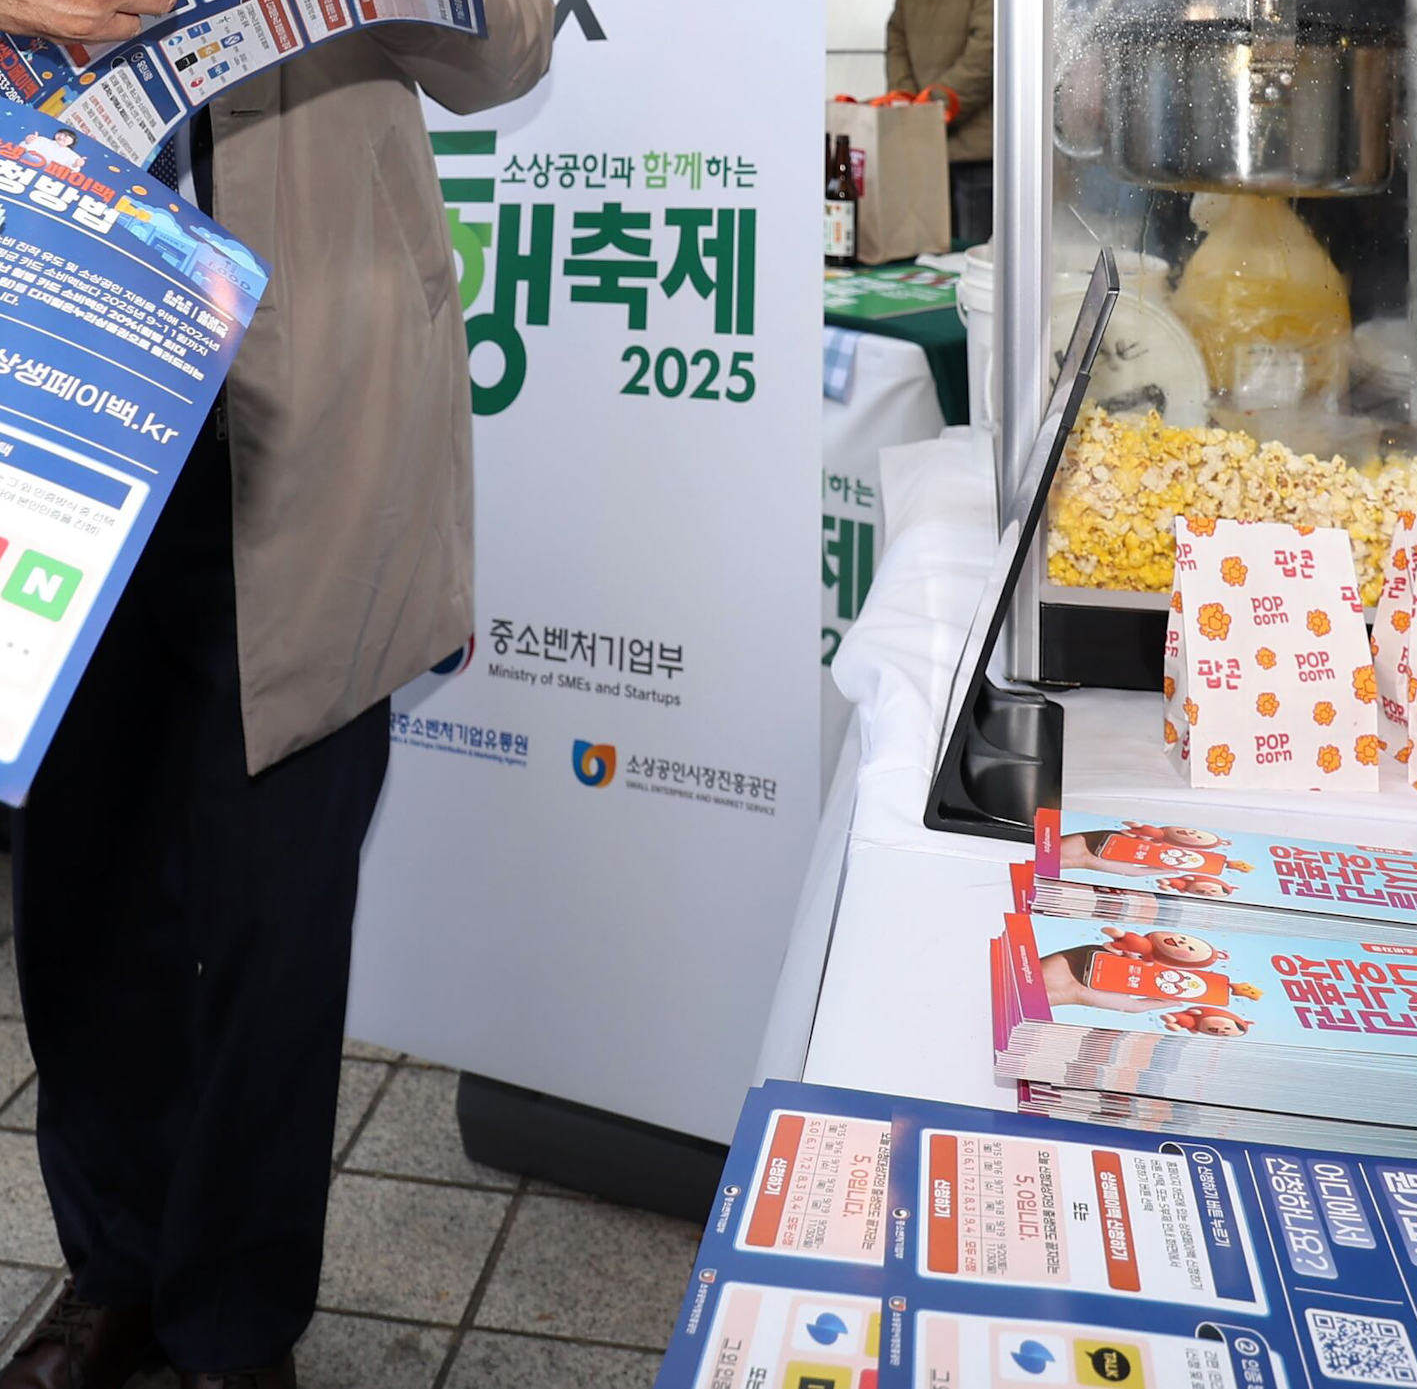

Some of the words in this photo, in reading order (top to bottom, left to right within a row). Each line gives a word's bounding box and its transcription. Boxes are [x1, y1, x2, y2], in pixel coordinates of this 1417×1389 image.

[500, 152, 635, 190] 소상공인과
[18, 255, 44, 274] 카드
[43, 264, 106, 299] 소비액보다
[35, 274, 60, 293] 카드
[40, 246, 64, 265] 유도
[78, 260, 122, 295] 소상공인
[123, 286, 154, 310] 지원을
[154, 302, 178, 325] 위해
[619, 345, 757, 403] 2025
[1274, 549, 1315, 580] 팝콘
[20, 566, 65, 604] N
[1250, 595, 1284, 612] POP
[1253, 612, 1290, 626] corn
[489, 617, 685, 680] 중소벤처기업부
[1294, 651, 1330, 669] POP
[488, 662, 537, 687] Ministry
[539, 670, 555, 685] of
[557, 673, 592, 692] SMEs
[594, 680, 621, 697] and
[623, 685, 682, 708] Startups
[1197, 658, 1242, 691] 팝콘
[1298, 668, 1336, 683] corn
[1254, 733, 1290, 751] POP
[1255, 750, 1293, 765] corn
[625, 754, 776, 802] 소상공인시장진흥공단
[1268, 845, 1335, 901] 상품권
[1318, 850, 1390, 907] 온누리
[1269, 953, 1363, 1033] 상품권
[933, 1178, 952, 1218] 신청하기
[1099, 1171, 1124, 1218] 상생페이백
[1196, 1165, 1218, 1200] 신청하기
[1015, 1189, 1040, 1242] 0입니다.
[1072, 1201, 1091, 1222] 또는
[1206, 1199, 1226, 1219] 버튼
[1264, 1156, 1330, 1271] 신청하나요?
[1312, 1163, 1371, 1243] 어디에서
[1106, 1218, 1129, 1261] 신청하기
[1209, 1218, 1232, 1248] 누르기
[1103, 1351, 1121, 1379] TALK
